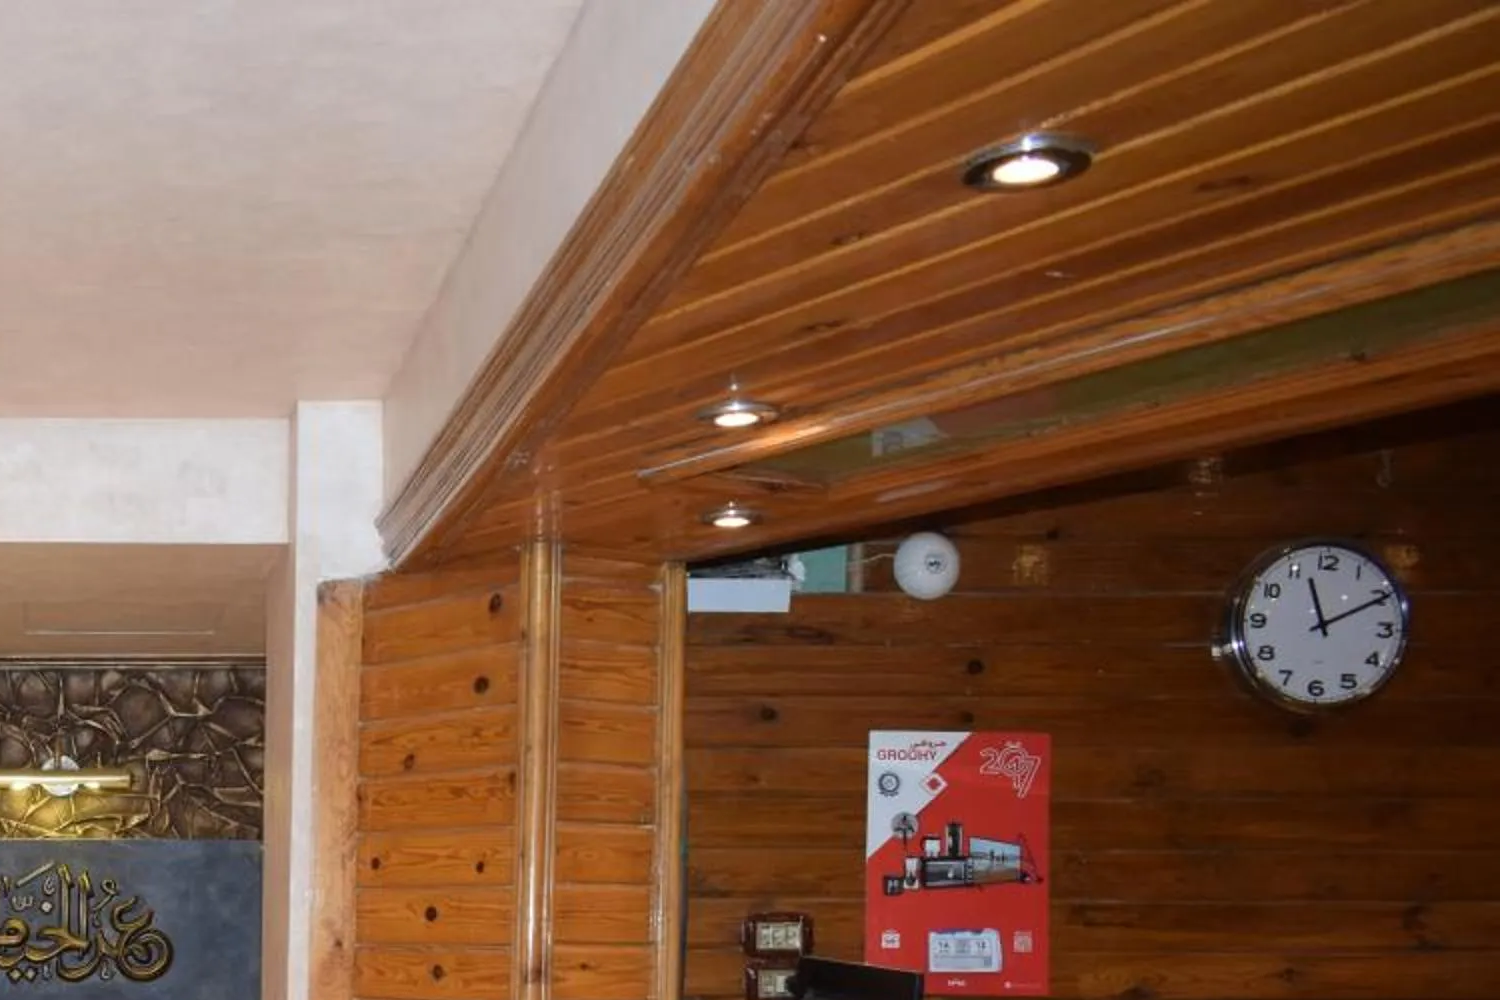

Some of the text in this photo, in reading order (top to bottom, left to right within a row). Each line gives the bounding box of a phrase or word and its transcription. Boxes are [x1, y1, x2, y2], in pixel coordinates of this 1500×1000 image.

[1317, 552, 1339, 571] 12
[1264, 583, 1281, 599] 10
[1250, 613, 1267, 629] 9
[1376, 621, 1394, 639] 3
[1257, 645, 1275, 661] 8
[1365, 651, 1379, 668] 4
[1279, 669, 1293, 686] 7
[1340, 673, 1357, 689] 5
[1307, 679, 1325, 697] 6
